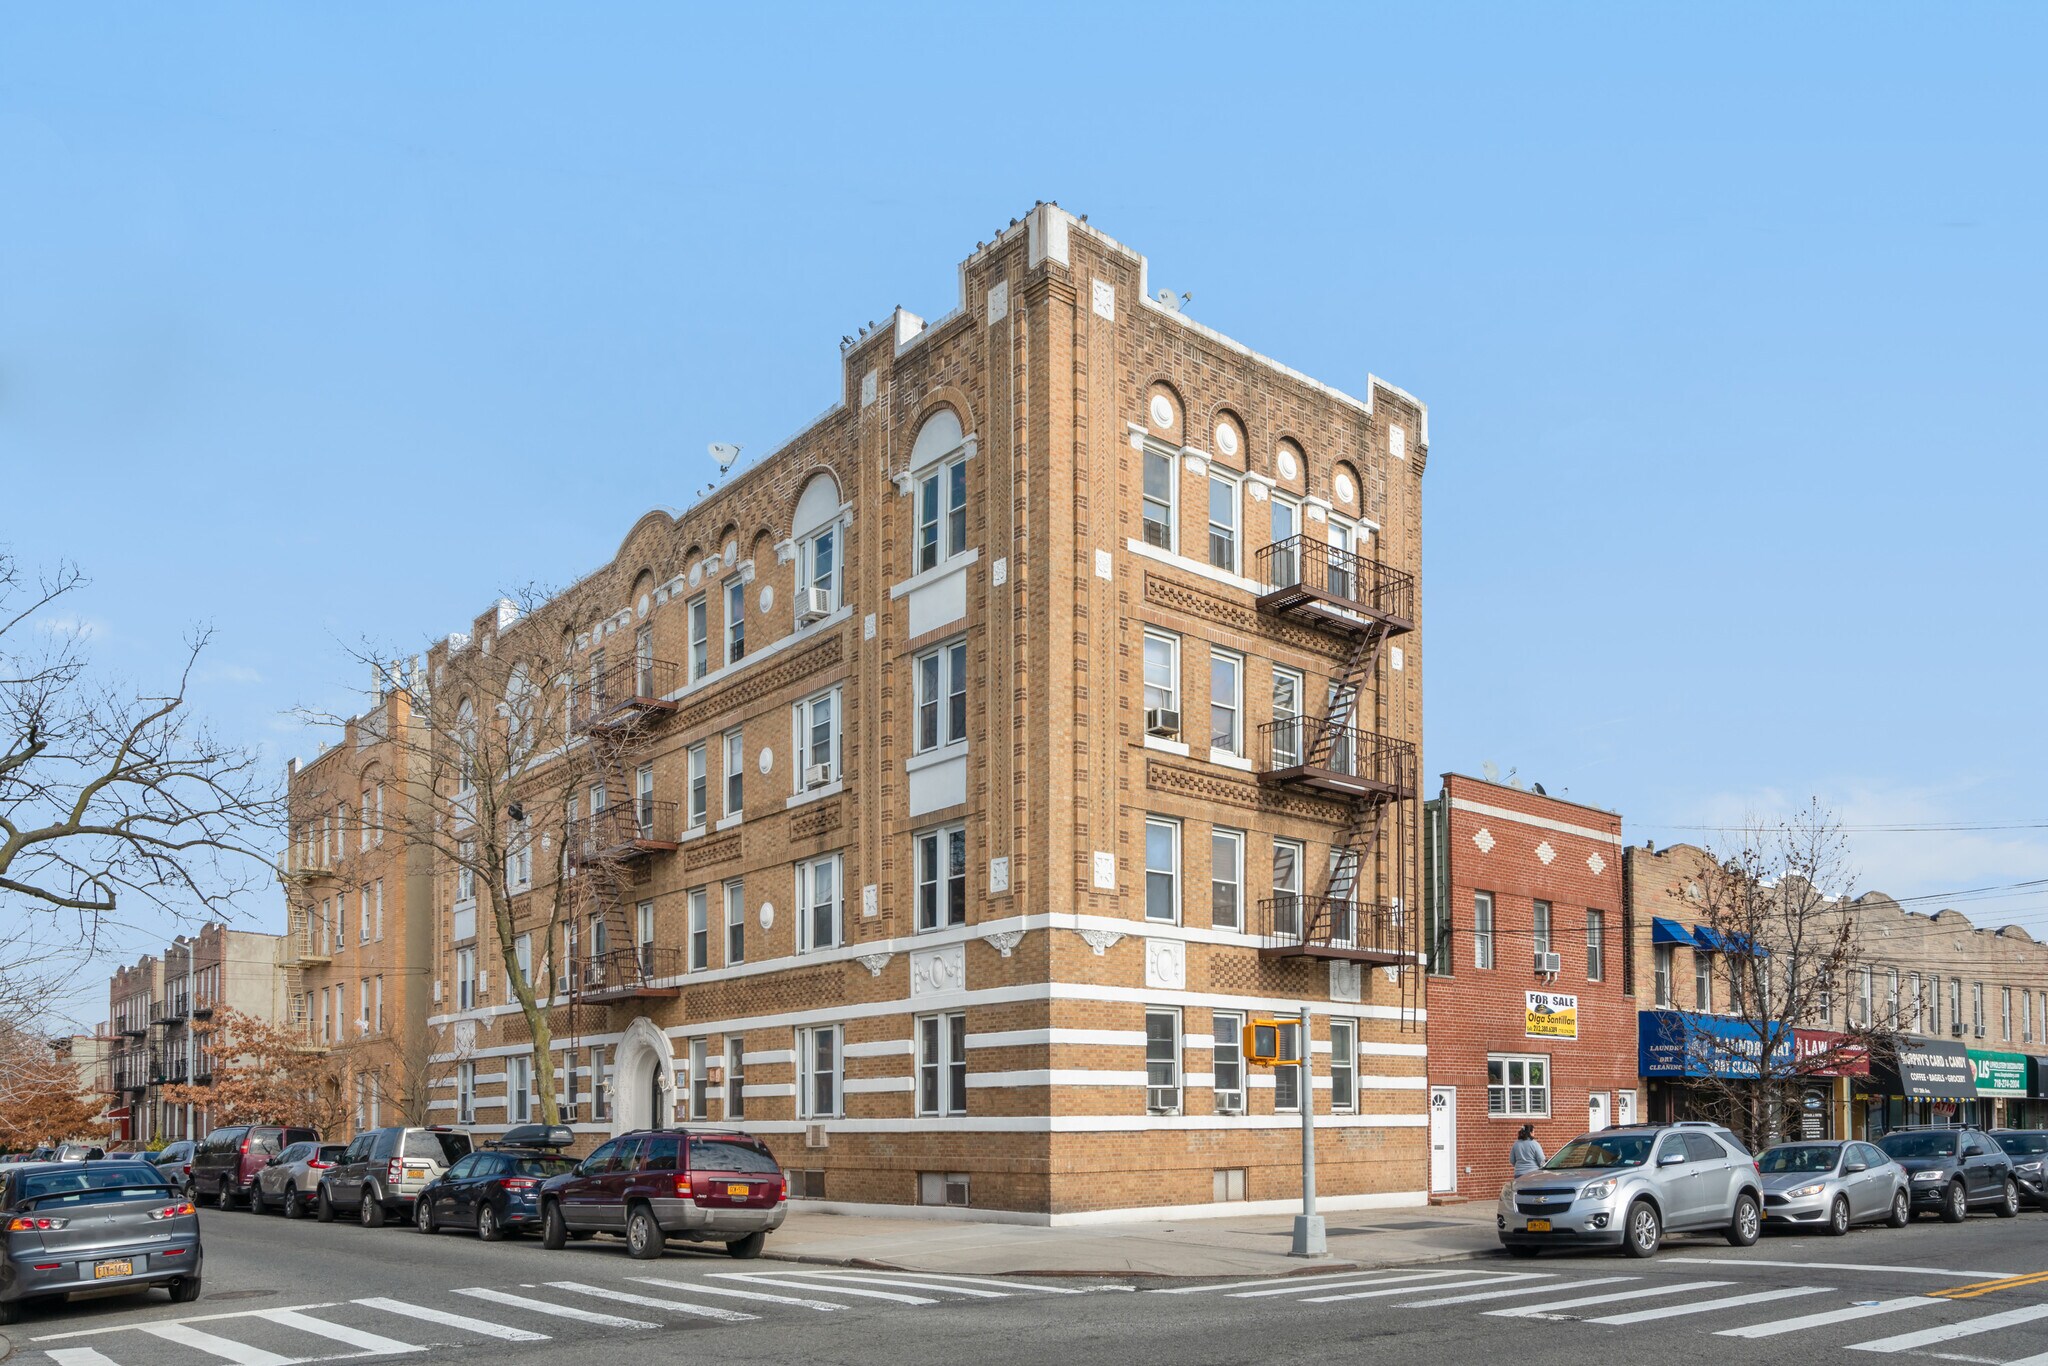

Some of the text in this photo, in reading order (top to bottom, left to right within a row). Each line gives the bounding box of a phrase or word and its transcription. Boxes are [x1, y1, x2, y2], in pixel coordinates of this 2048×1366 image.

[1530, 994, 1574, 1007] FOR SALE
[1528, 1012, 1575, 1026] Olga Santillan
[1715, 1036, 1791, 1057] LAUNDRAT
[1805, 1039, 1828, 1056] LAW
[1929, 1054, 1945, 1068] CARD
[1948, 1055, 1967, 1069] CANDY
[1910, 1072, 1966, 1083] COFFEE BAGELS GROCERY
[1933, 1101, 1956, 1113] ATM
